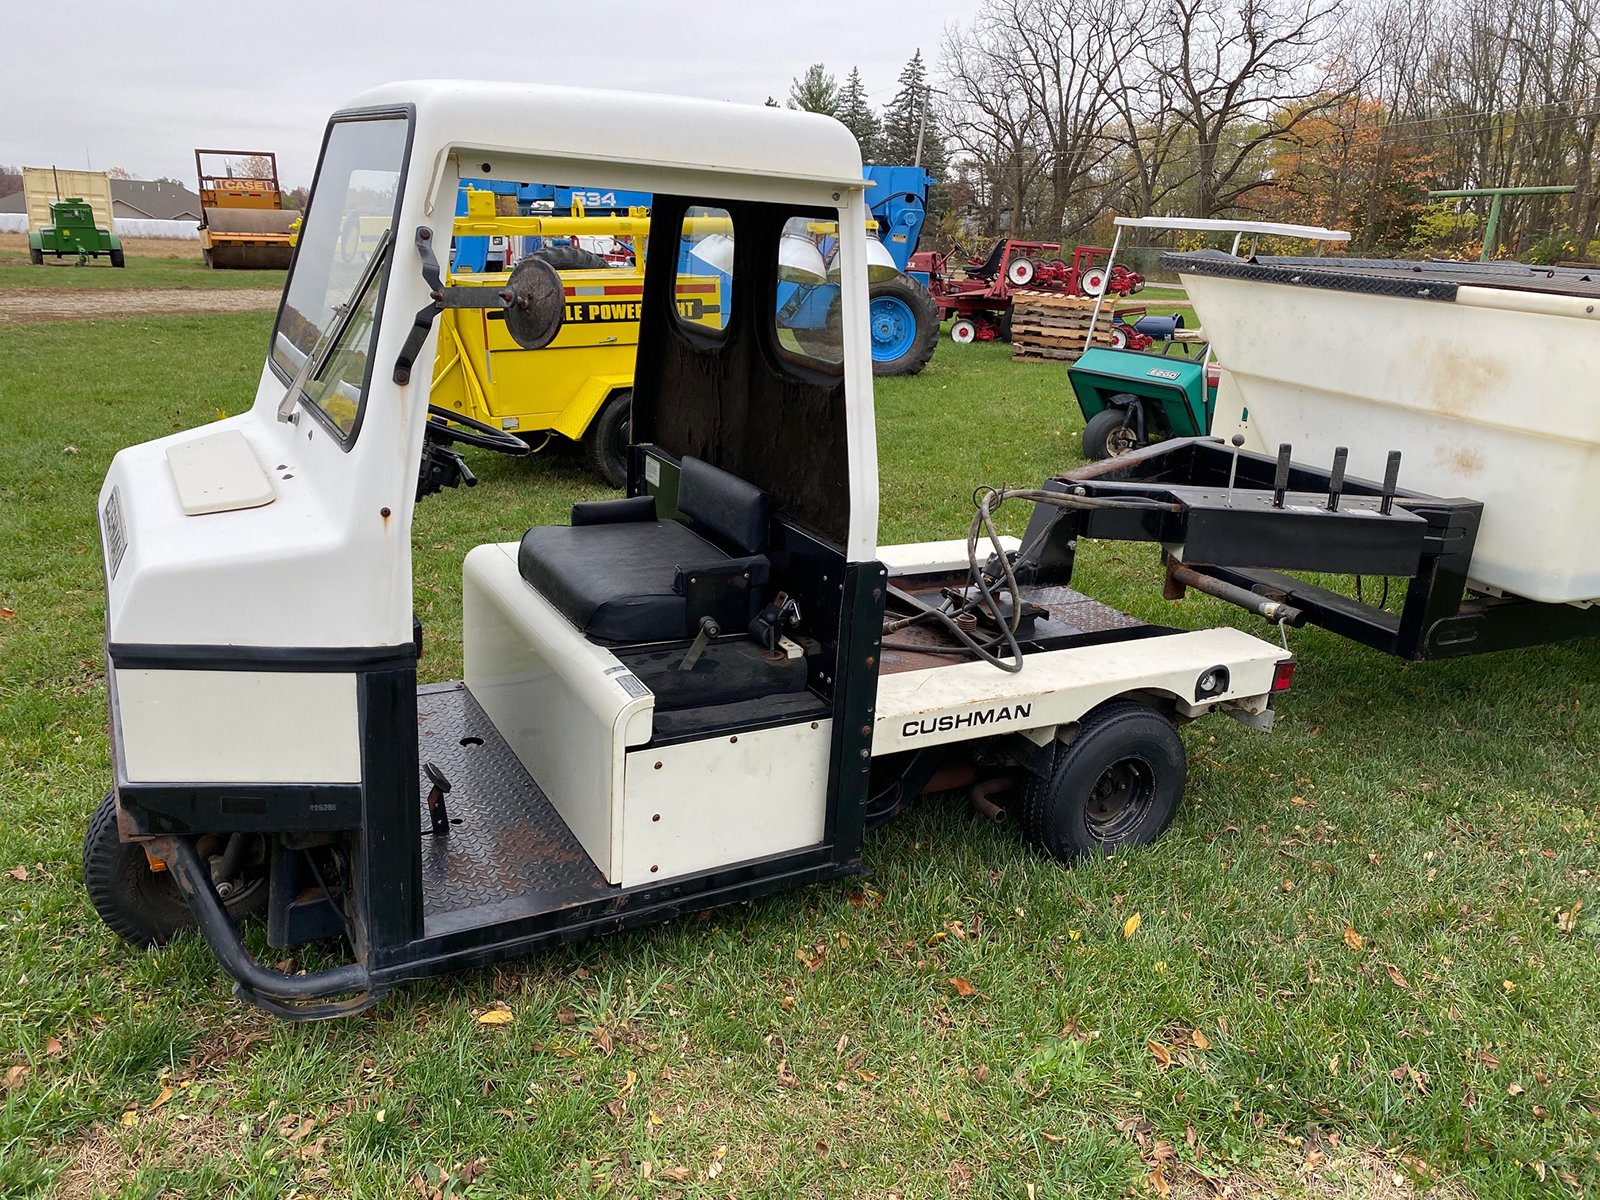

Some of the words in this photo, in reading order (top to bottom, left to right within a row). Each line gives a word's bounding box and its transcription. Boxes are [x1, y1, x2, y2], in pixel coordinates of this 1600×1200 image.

[224, 180, 265, 190] CASE
[571, 191, 617, 207] 534
[902, 703, 1032, 738] CUSHMAN
